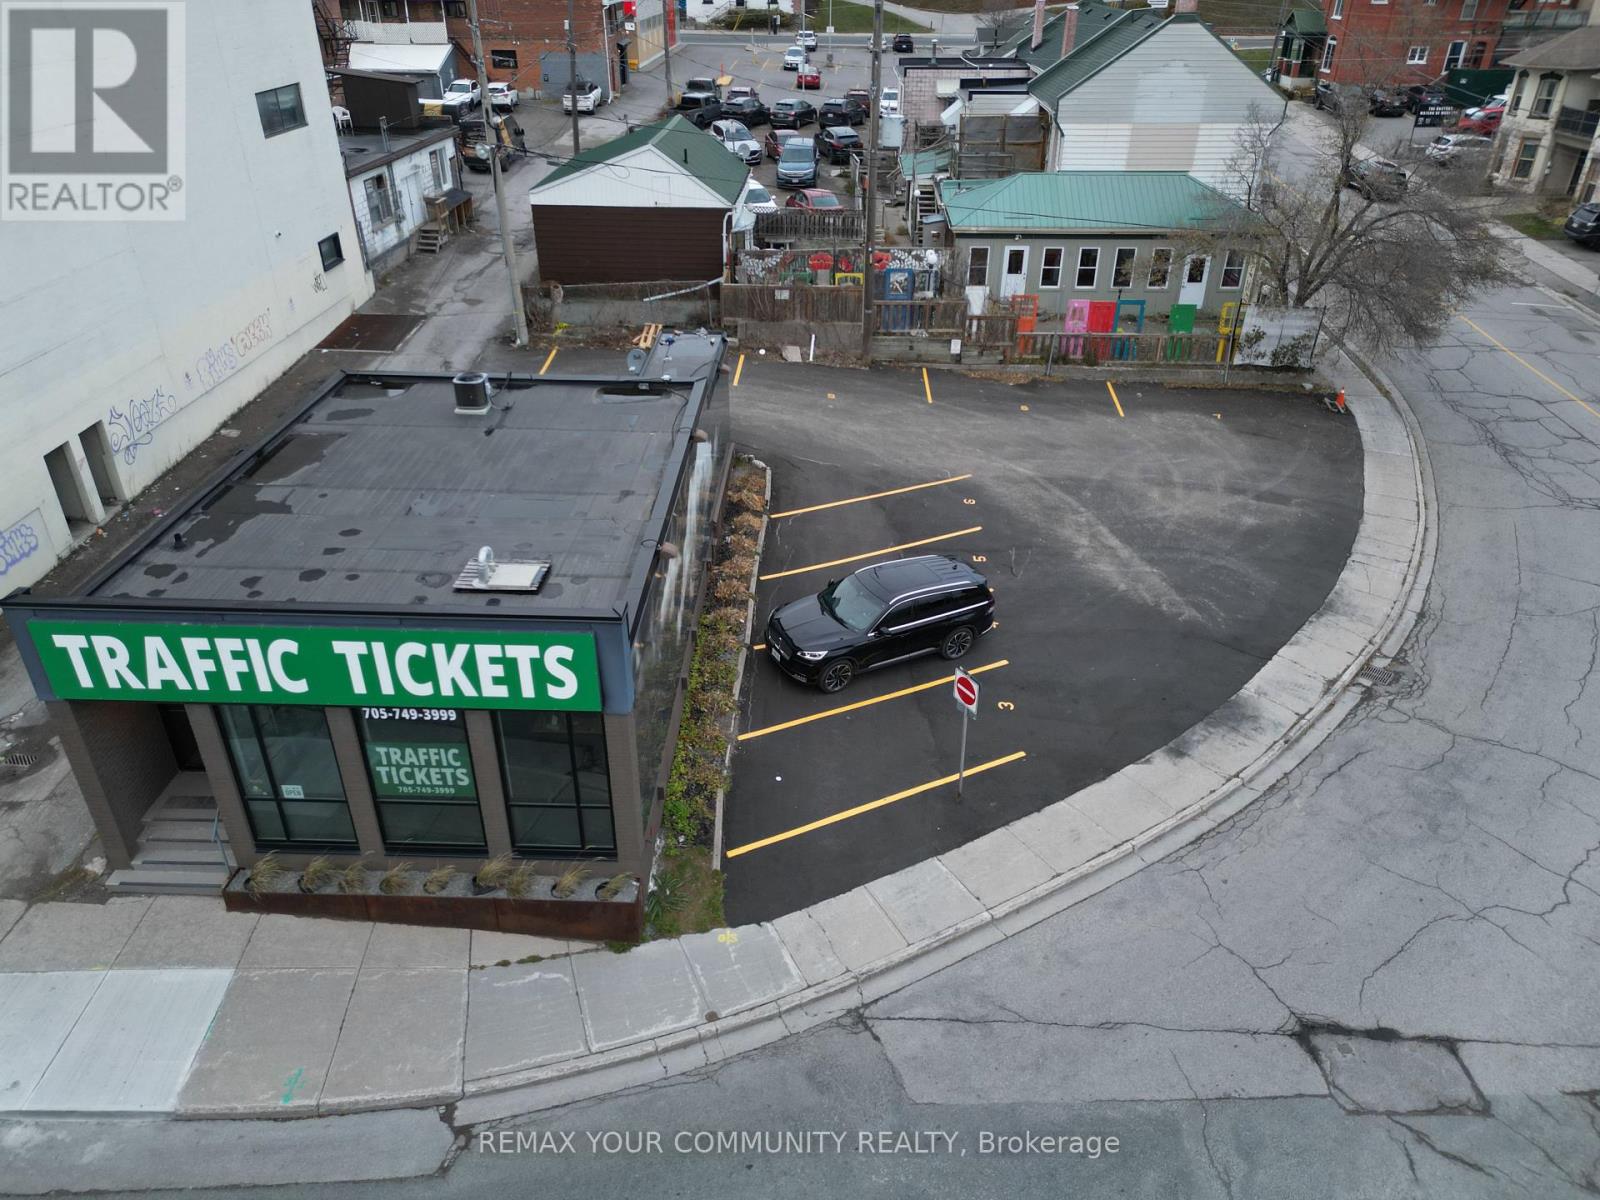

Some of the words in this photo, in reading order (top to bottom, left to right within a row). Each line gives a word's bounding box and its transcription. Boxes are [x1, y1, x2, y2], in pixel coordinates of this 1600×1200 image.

[973, 555, 987, 563] 5
[51, 633, 309, 694] TRAFFIC
[331, 640, 578, 700] TICKETS
[362, 707, 457, 721] 705-749-3999
[998, 701, 1015, 711] 3
[375, 747, 462, 767] TRAFFIC
[376, 766, 470, 786] TICKETS
